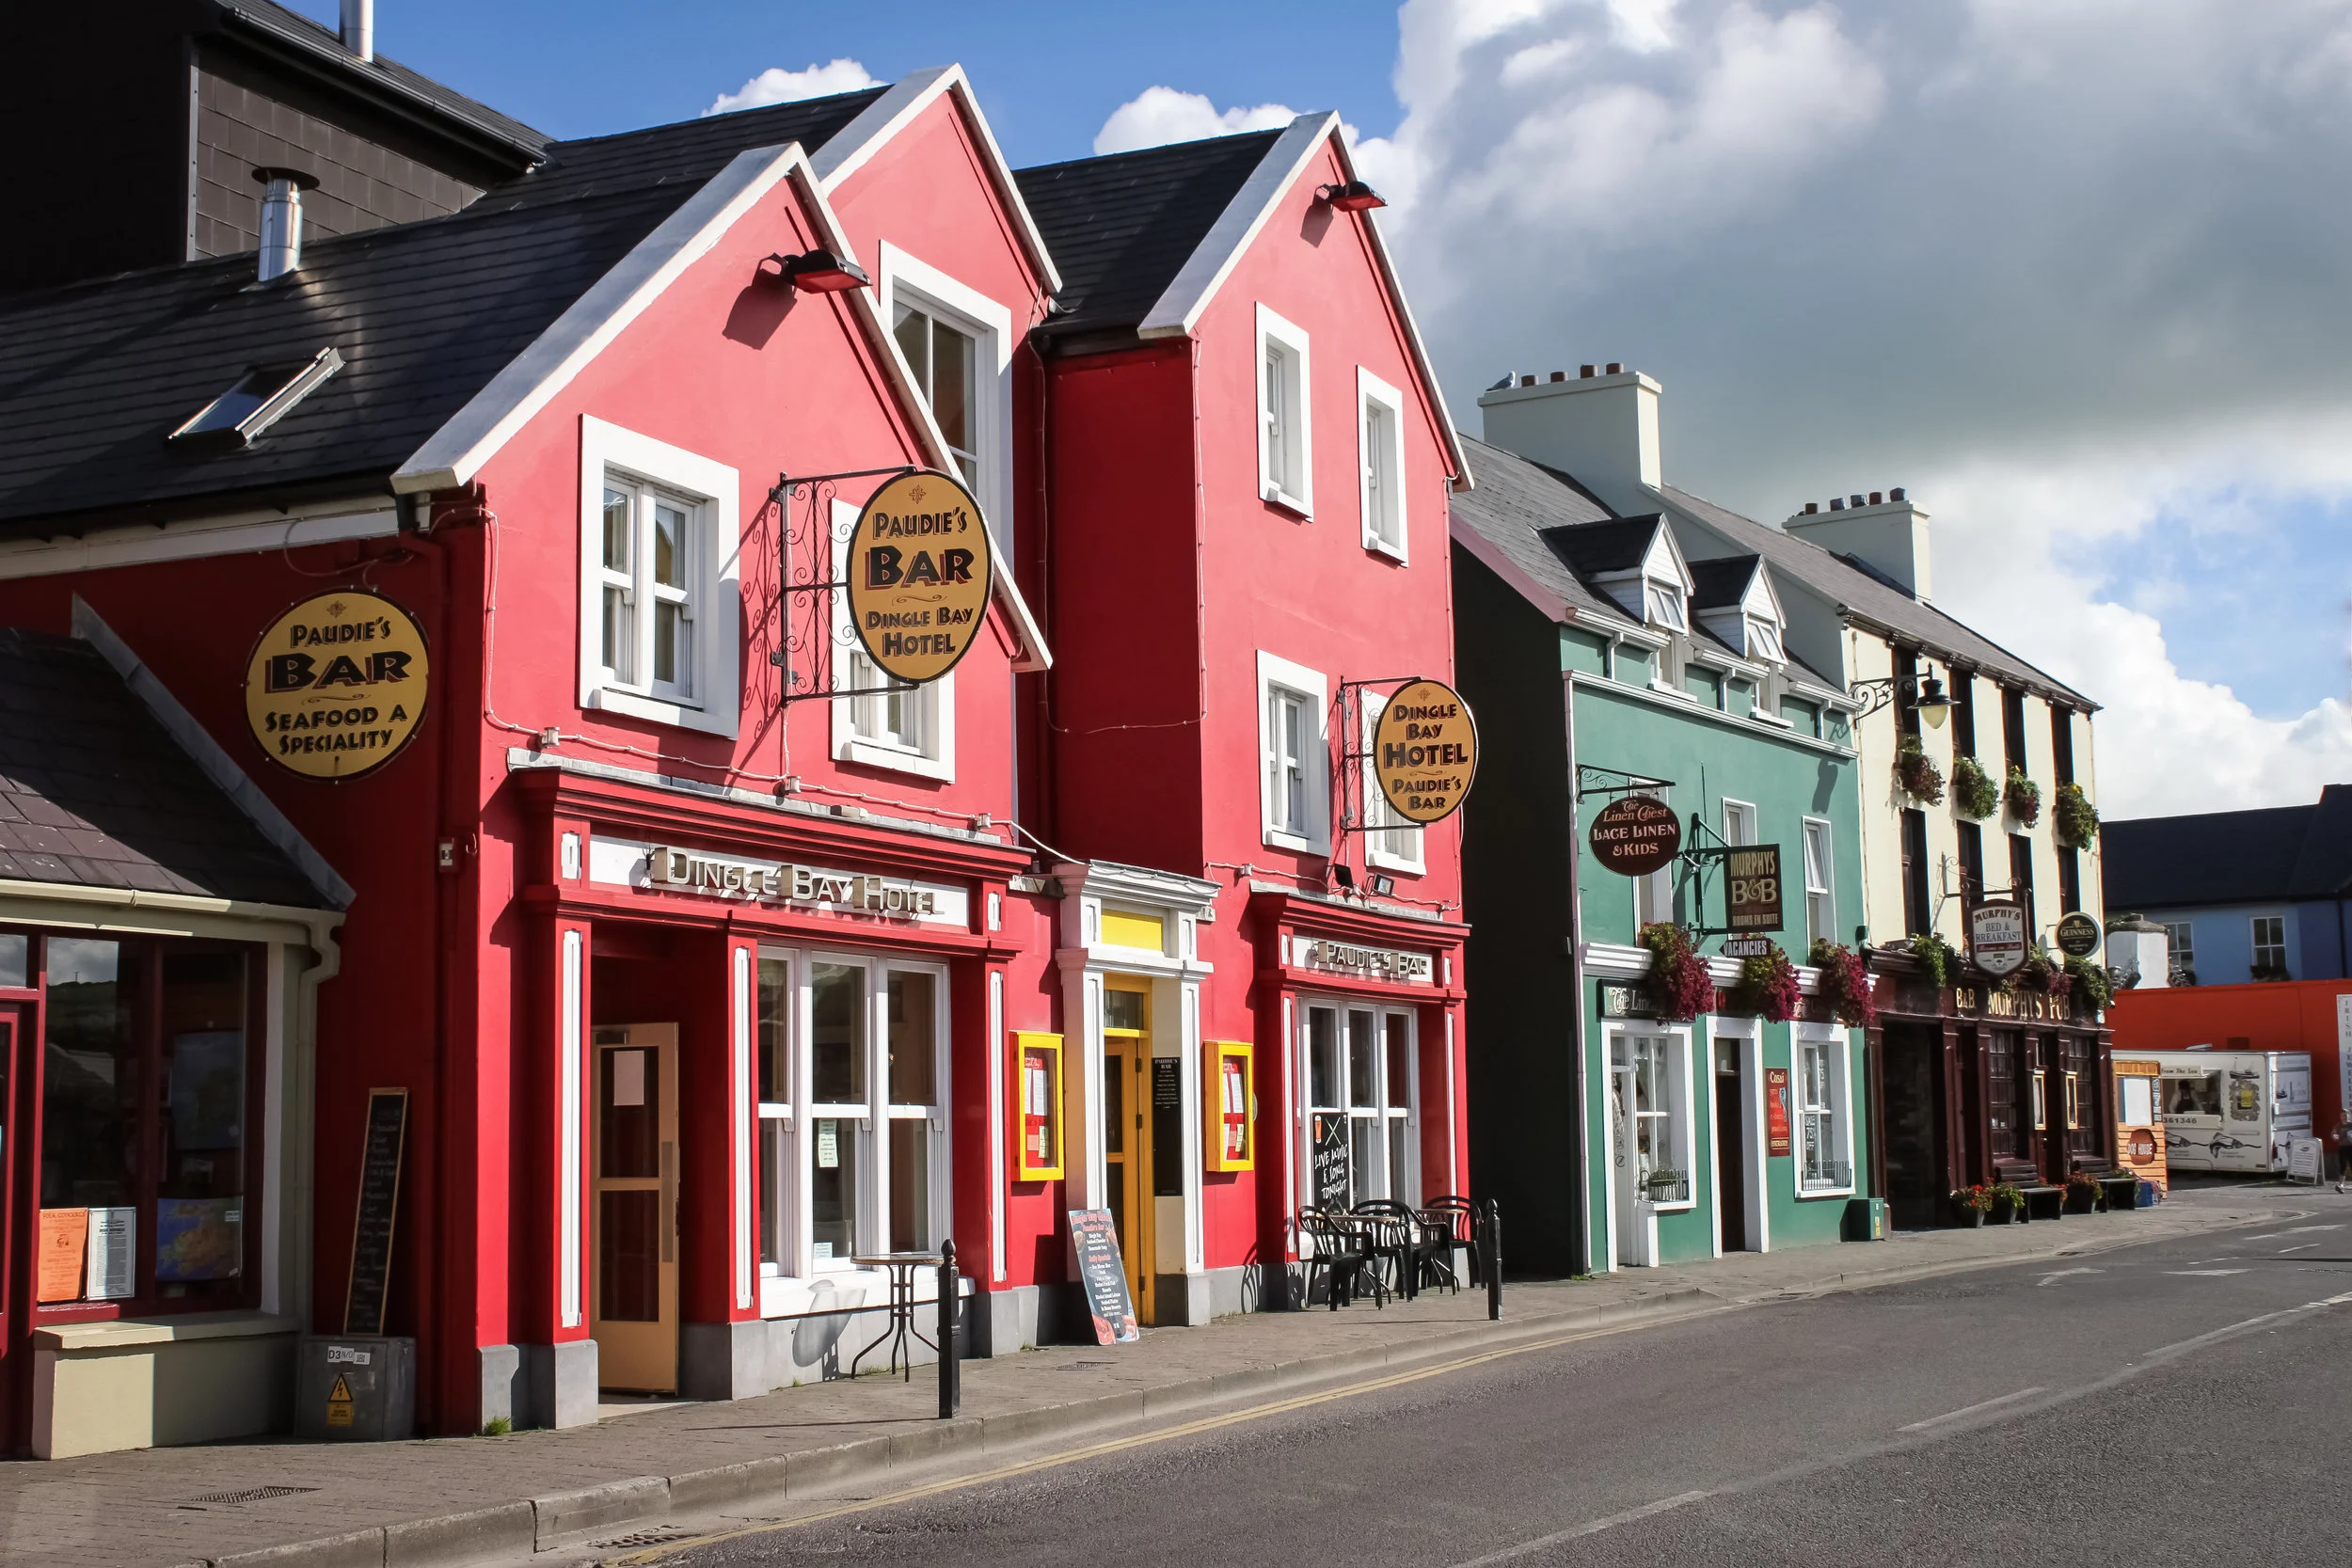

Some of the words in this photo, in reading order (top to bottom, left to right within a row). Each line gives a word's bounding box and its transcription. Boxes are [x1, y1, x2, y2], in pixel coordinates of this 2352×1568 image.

[873, 507, 967, 540] PAUDIE'S
[865, 546, 975, 591] BAR
[866, 610, 930, 629] DINGLE
[937, 607, 974, 626] BAY
[291, 616, 390, 648] PAUDIE'S
[882, 632, 956, 657] HOTEL
[264, 651, 412, 693] BAR
[265, 706, 378, 733] SEAFOOD
[388, 705, 407, 722] A
[1393, 704, 1456, 721] DINGLE
[1406, 723, 1442, 740] BAY
[278, 729, 393, 755] SPECIALITY
[1383, 742, 1469, 768] HOTEL
[1392, 776, 1461, 795] PAUDIE'S
[1408, 796, 1446, 811] BAR
[1622, 800, 1639, 812] The
[1603, 810, 1634, 822] Linen
[1637, 805, 1668, 821] Chest
[1594, 827, 1629, 841] LACE
[1632, 823, 1676, 837] LINEN
[1731, 851, 1775, 877] MURPHYS
[653, 847, 778, 895] DINGLE
[780, 863, 850, 902] BAY
[852, 875, 945, 915] HOTEL
[1732, 879, 1777, 905] B&B
[1733, 915, 1753, 926] ROOMS
[1762, 913, 1778, 925] SUITE
[1975, 909, 2021, 923] MURPHY'S
[1976, 931, 2021, 942] BREAKFAST
[1985, 922, 2001, 932] BED
[2060, 927, 2095, 937] GUINNESS
[1724, 941, 1767, 957] VACANCIES
[1391, 952, 1428, 979] BAR
[1608, 987, 1629, 1013] The
[1956, 988, 1975, 1009] B&B
[1314, 1151, 1329, 1169] LIVE
[1329, 1163, 1344, 1182] SONG
[1321, 1180, 1347, 1199] TONIGHT
[328, 1350, 342, 1360] D3
